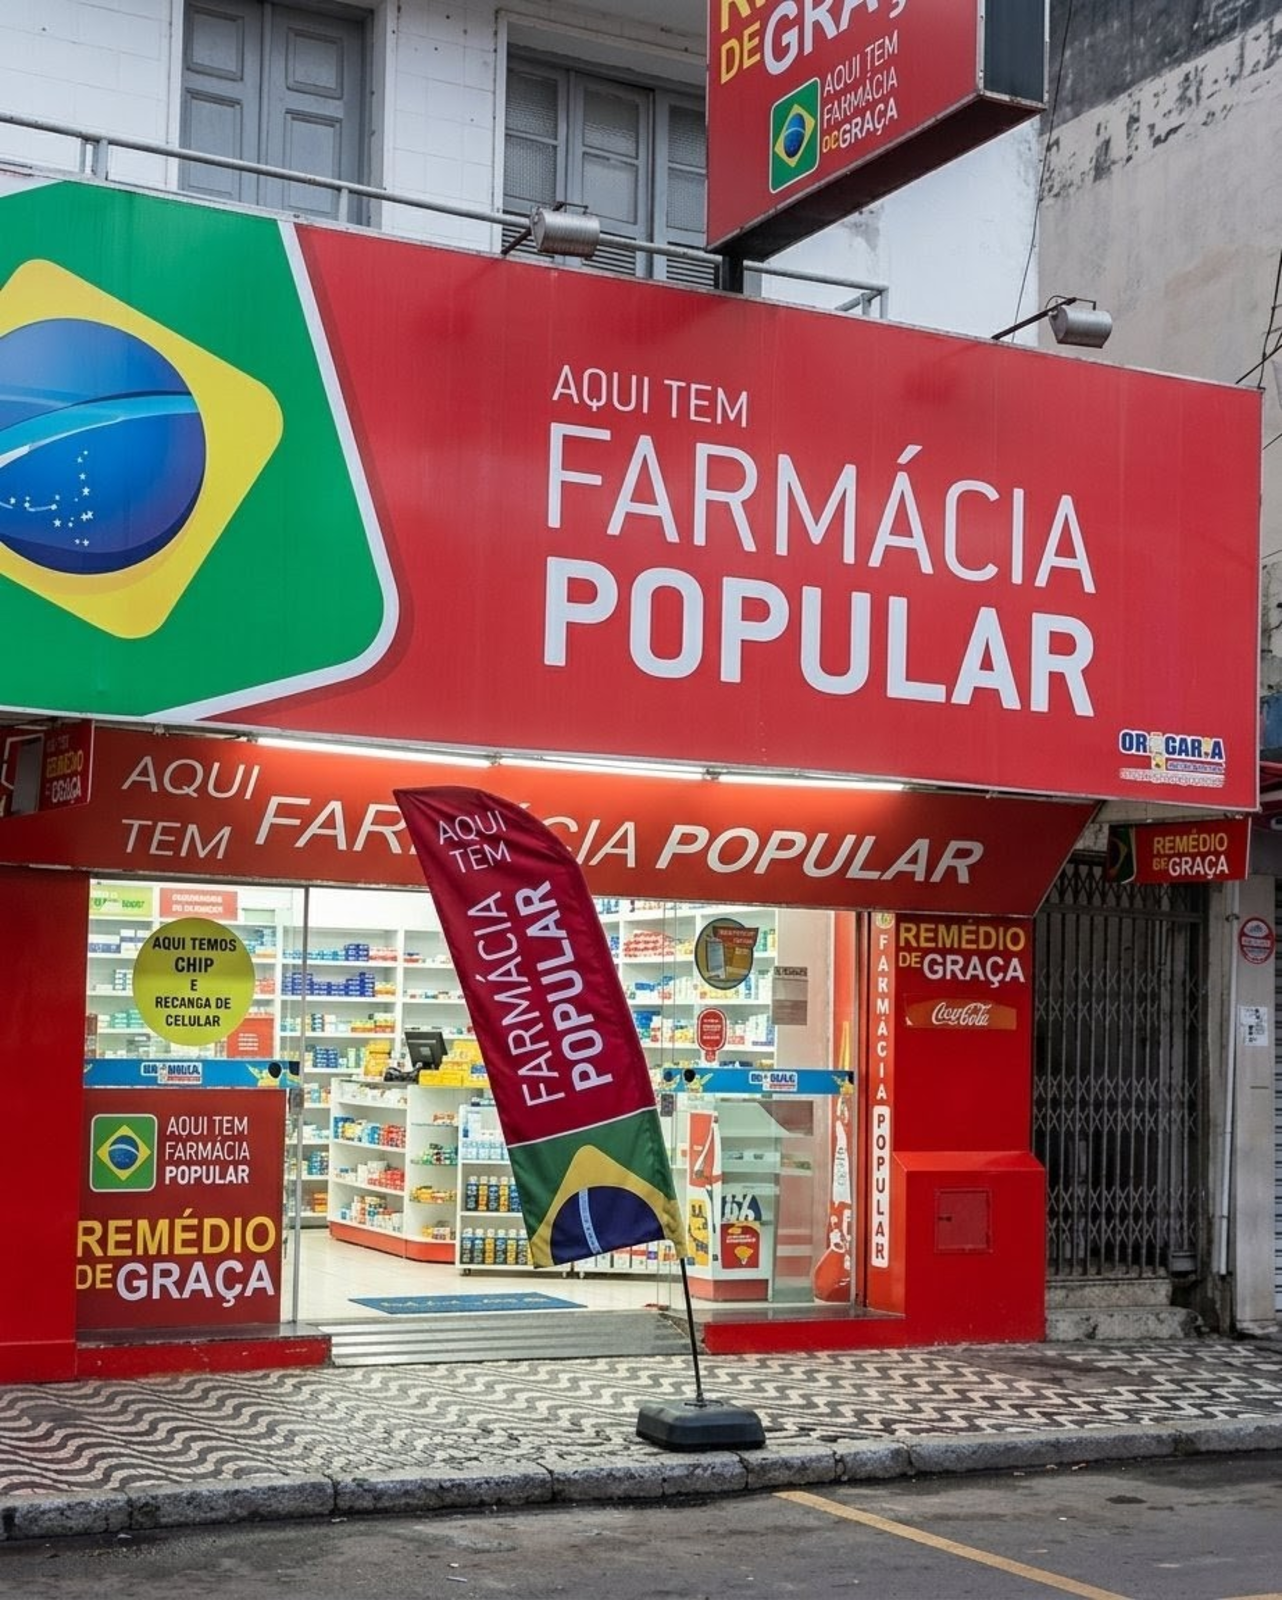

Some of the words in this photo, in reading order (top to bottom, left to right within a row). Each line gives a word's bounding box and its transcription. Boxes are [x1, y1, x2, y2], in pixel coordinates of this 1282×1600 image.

[720, 20, 761, 86] DE
[823, 53, 860, 98] AQUI
[864, 30, 898, 71] TEM
[823, 66, 898, 130] FARMÁCIA
[839, 97, 898, 149] GRAÇA
[552, 364, 650, 412] AQUI
[664, 379, 749, 427] TEM
[546, 421, 1097, 594] FARMÁCIA
[543, 556, 1095, 717] POPULAR
[121, 756, 261, 800] AQUI
[121, 819, 233, 859] TEM
[438, 810, 507, 845] AQUI
[1153, 828, 1228, 855] REMÉDIO
[449, 840, 512, 874] TEM
[655, 824, 984, 884] POPULAR
[1168, 854, 1230, 879] GRAÇA
[152, 936, 186, 951] AQUI
[190, 937, 237, 952] TEMOS
[899, 919, 1026, 952] REMÉDIO
[174, 956, 215, 973] CHIP
[190, 979, 198, 991] E
[515, 880, 614, 1091] POPULAR
[898, 952, 922, 968] DE
[922, 953, 1026, 988] GRAÇA
[155, 996, 212, 1009] RECANGA
[215, 998, 231, 1009] DE
[467, 891, 566, 1107] FARMÁCIA
[876, 934, 890, 1100] FARMÁCIA
[165, 1014, 221, 1027] CELULAR
[166, 1115, 208, 1139] AQUI
[212, 1116, 248, 1136] TEM
[164, 1137, 250, 1161] FARMÁCIA
[164, 1165, 250, 1185] POPULAR
[875, 1113, 886, 1260] POPULAR
[76, 1208, 276, 1257] REMÉDIO
[75, 1263, 114, 1290] DE
[116, 1259, 275, 1308] GRAÇA
